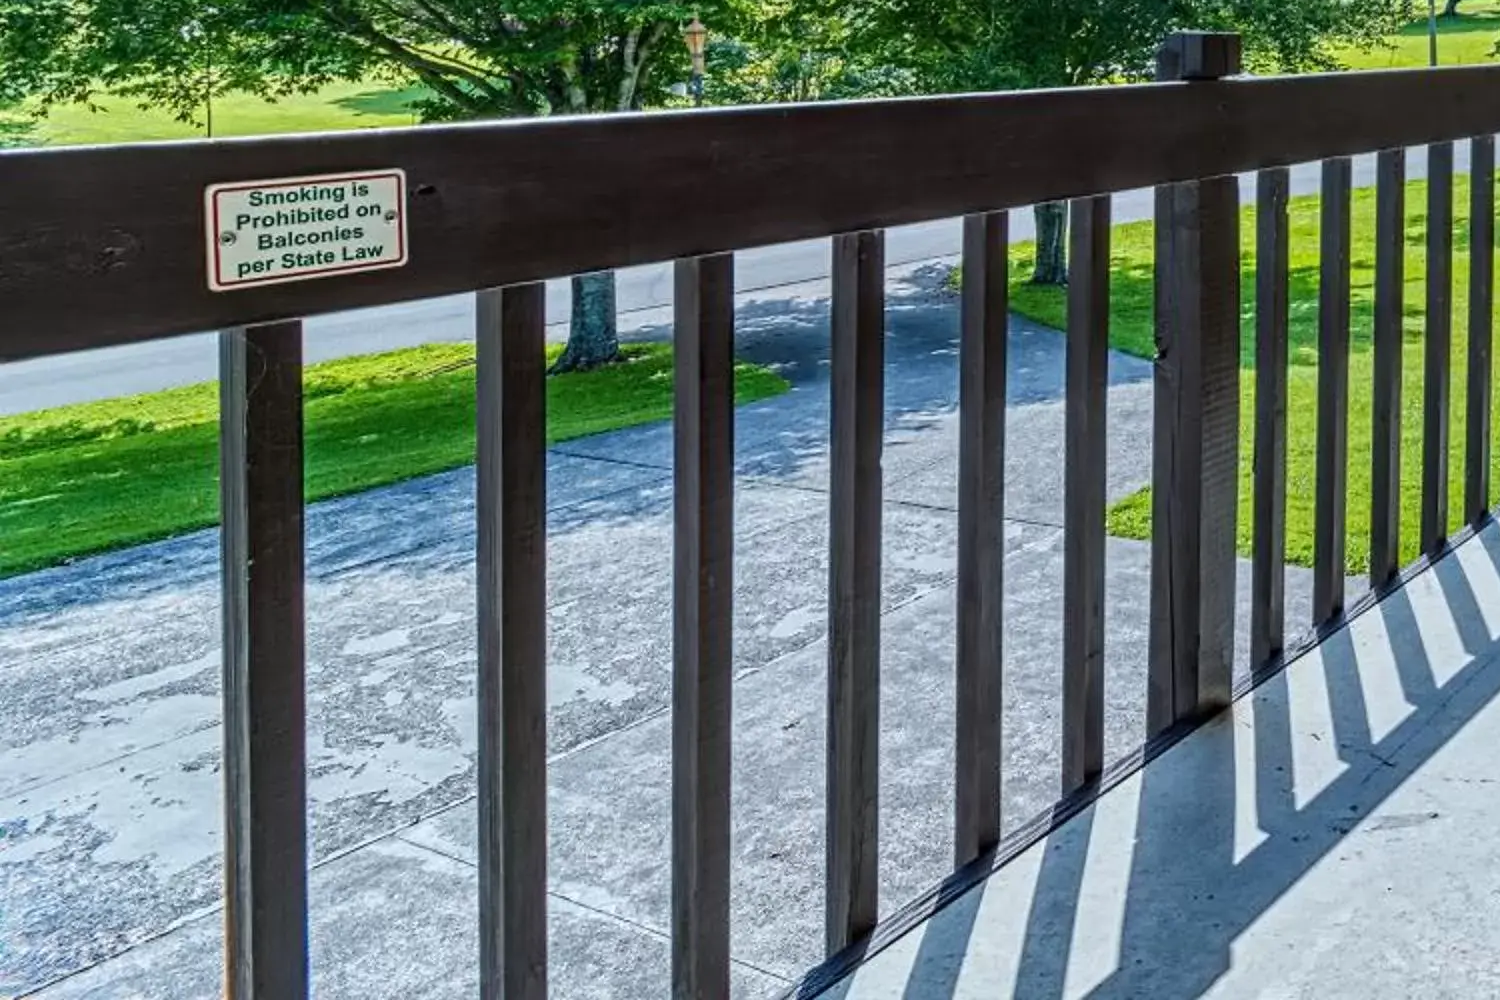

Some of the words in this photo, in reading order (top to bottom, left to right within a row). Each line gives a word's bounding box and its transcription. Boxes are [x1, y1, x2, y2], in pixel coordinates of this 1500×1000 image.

[249, 185, 345, 207] Smoking
[352, 182, 369, 197] is
[236, 204, 349, 230] Prohibited
[356, 203, 382, 217] on
[257, 226, 364, 250] Balconies
[237, 258, 274, 278] per
[281, 251, 335, 269] State
[342, 244, 384, 261] Law
